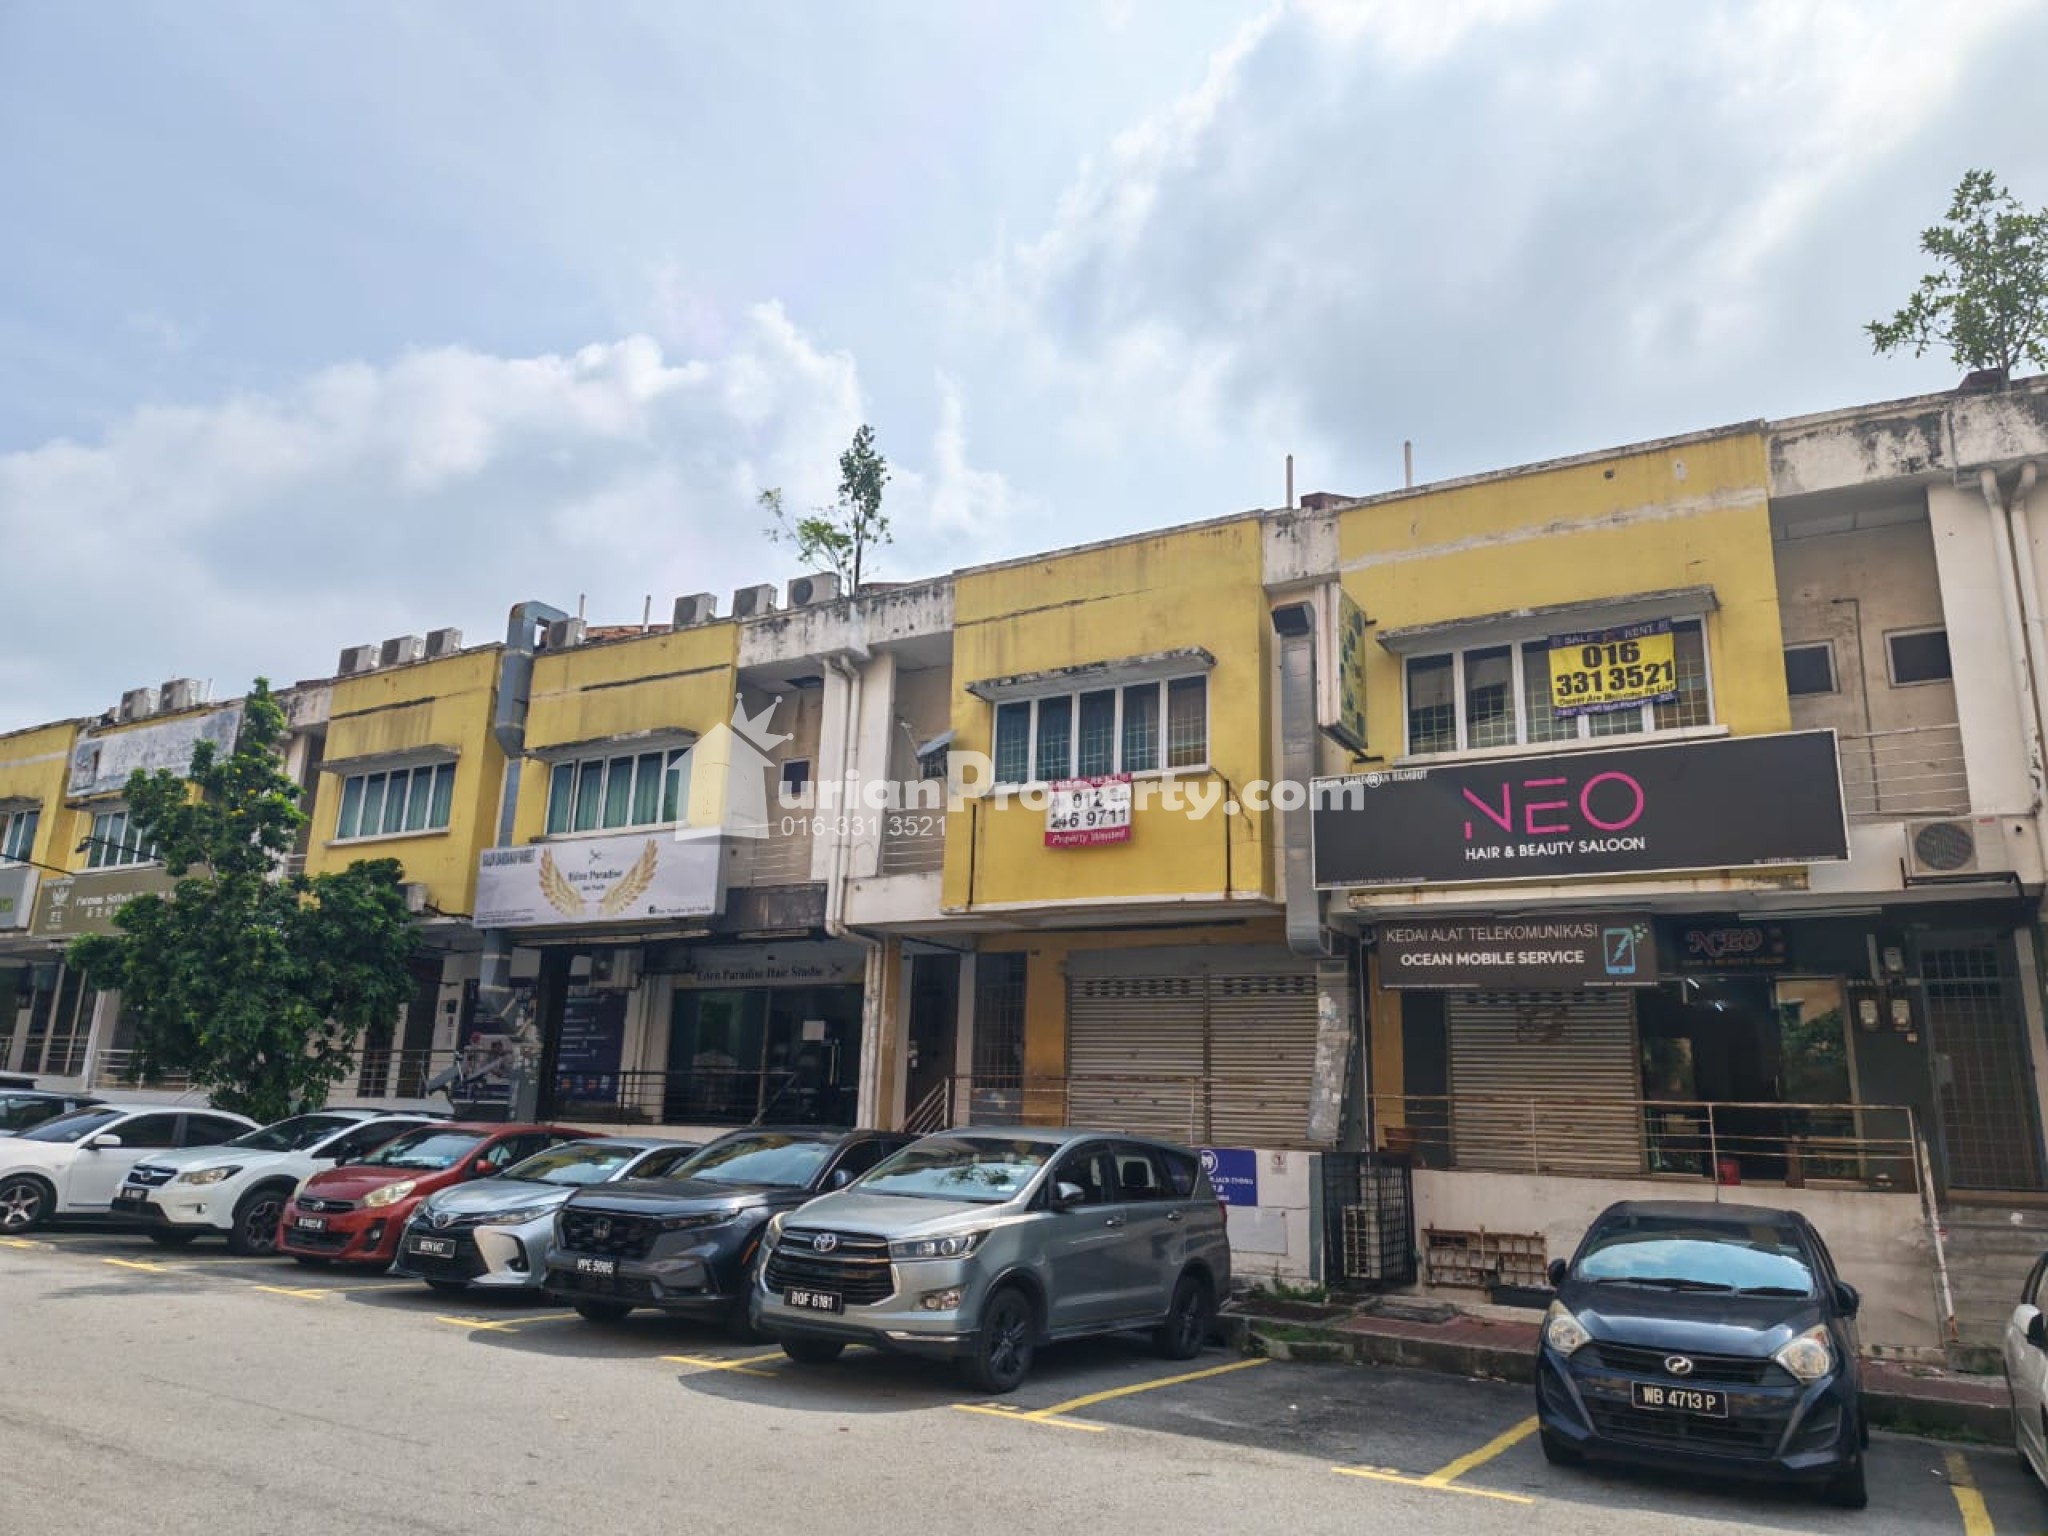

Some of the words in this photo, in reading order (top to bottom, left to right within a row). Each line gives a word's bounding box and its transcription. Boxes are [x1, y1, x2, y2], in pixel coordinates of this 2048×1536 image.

[1582, 642, 1640, 668] 016
[1556, 670, 1603, 697] 331
[1609, 660, 1673, 690] 3521
[1463, 771, 1645, 840] NEO
[1464, 845, 1501, 860] HAIR
[1504, 845, 1515, 858] &
[1519, 841, 1574, 857] BEAUTY
[1578, 836, 1646, 854] SALOON
[1386, 929, 1428, 943] KEDAI
[1430, 927, 1464, 941] ALAT
[1470, 923, 1599, 941] TELEKOMUNIKASI
[1401, 953, 1453, 967] OCEAN
[1456, 951, 1517, 966] MOBILE
[1519, 950, 1585, 964] SERVICE
[1643, 1386, 1664, 1404] WB
[1668, 1389, 1703, 1409] 4713
[1706, 1394, 1717, 1412] P
